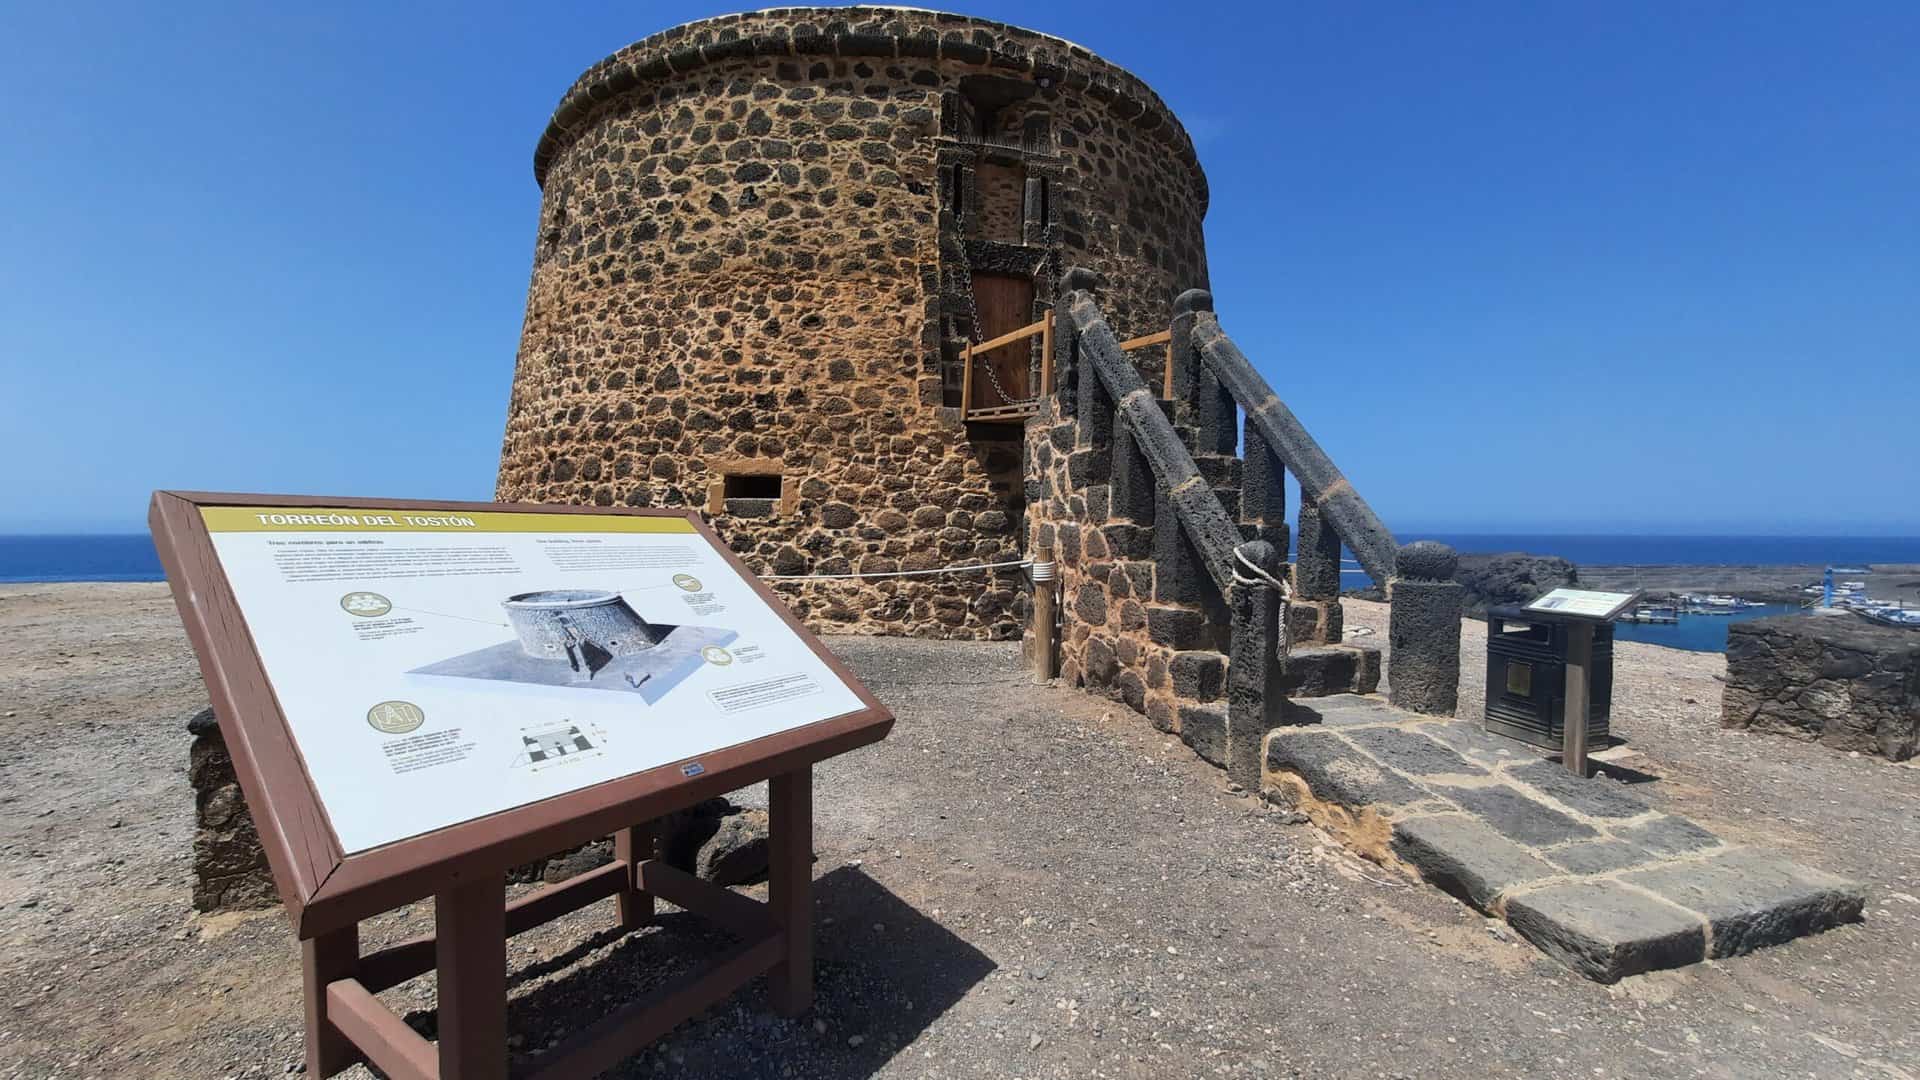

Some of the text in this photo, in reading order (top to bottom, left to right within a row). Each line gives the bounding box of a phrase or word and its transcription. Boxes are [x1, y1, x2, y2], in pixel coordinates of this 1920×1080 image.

[256, 514, 475, 527] TORREÓN DEL TOSTÓN
